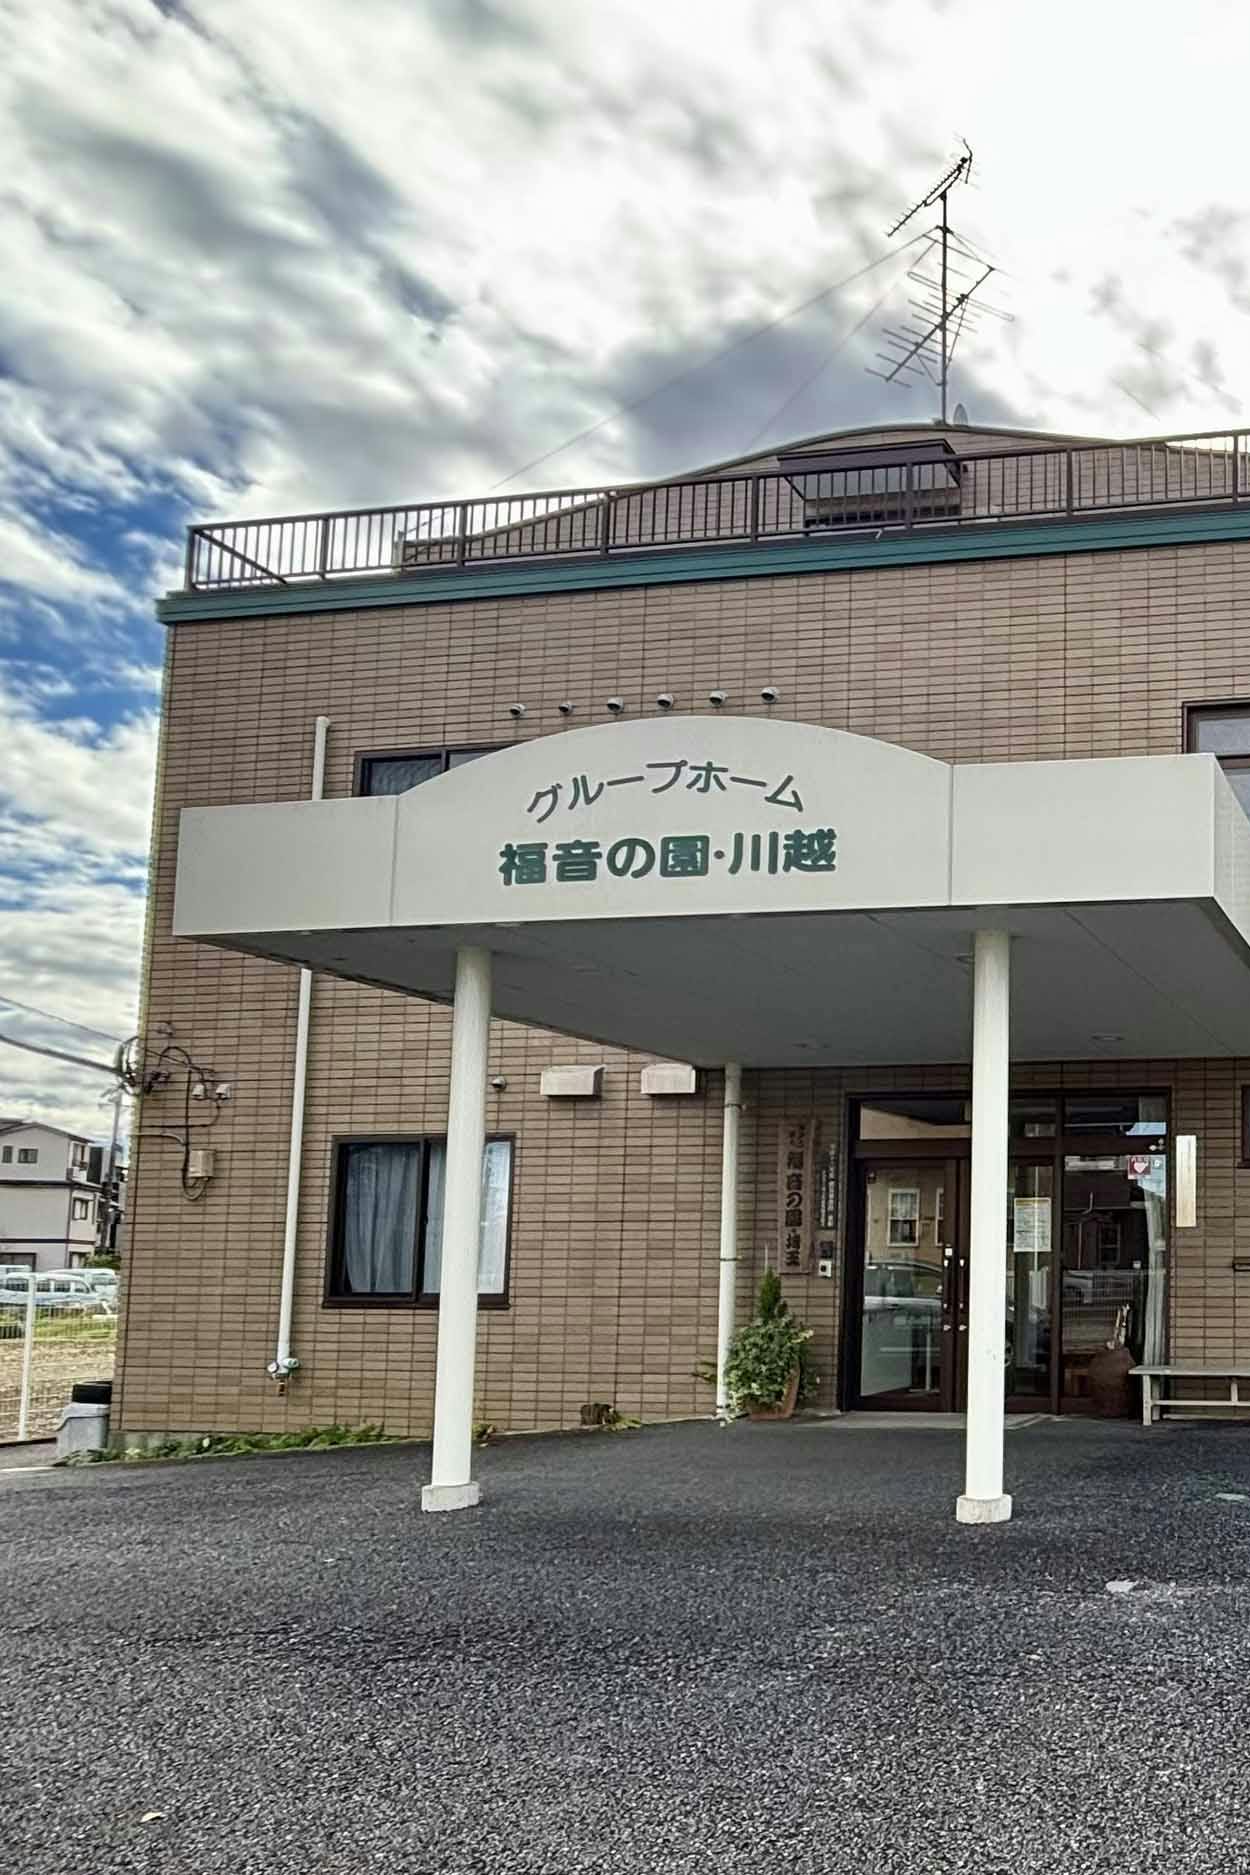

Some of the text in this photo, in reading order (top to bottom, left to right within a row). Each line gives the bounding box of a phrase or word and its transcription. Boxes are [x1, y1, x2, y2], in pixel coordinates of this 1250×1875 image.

[527, 759, 803, 823] グループホーム
[499, 828, 837, 886] 福音の園・川越
